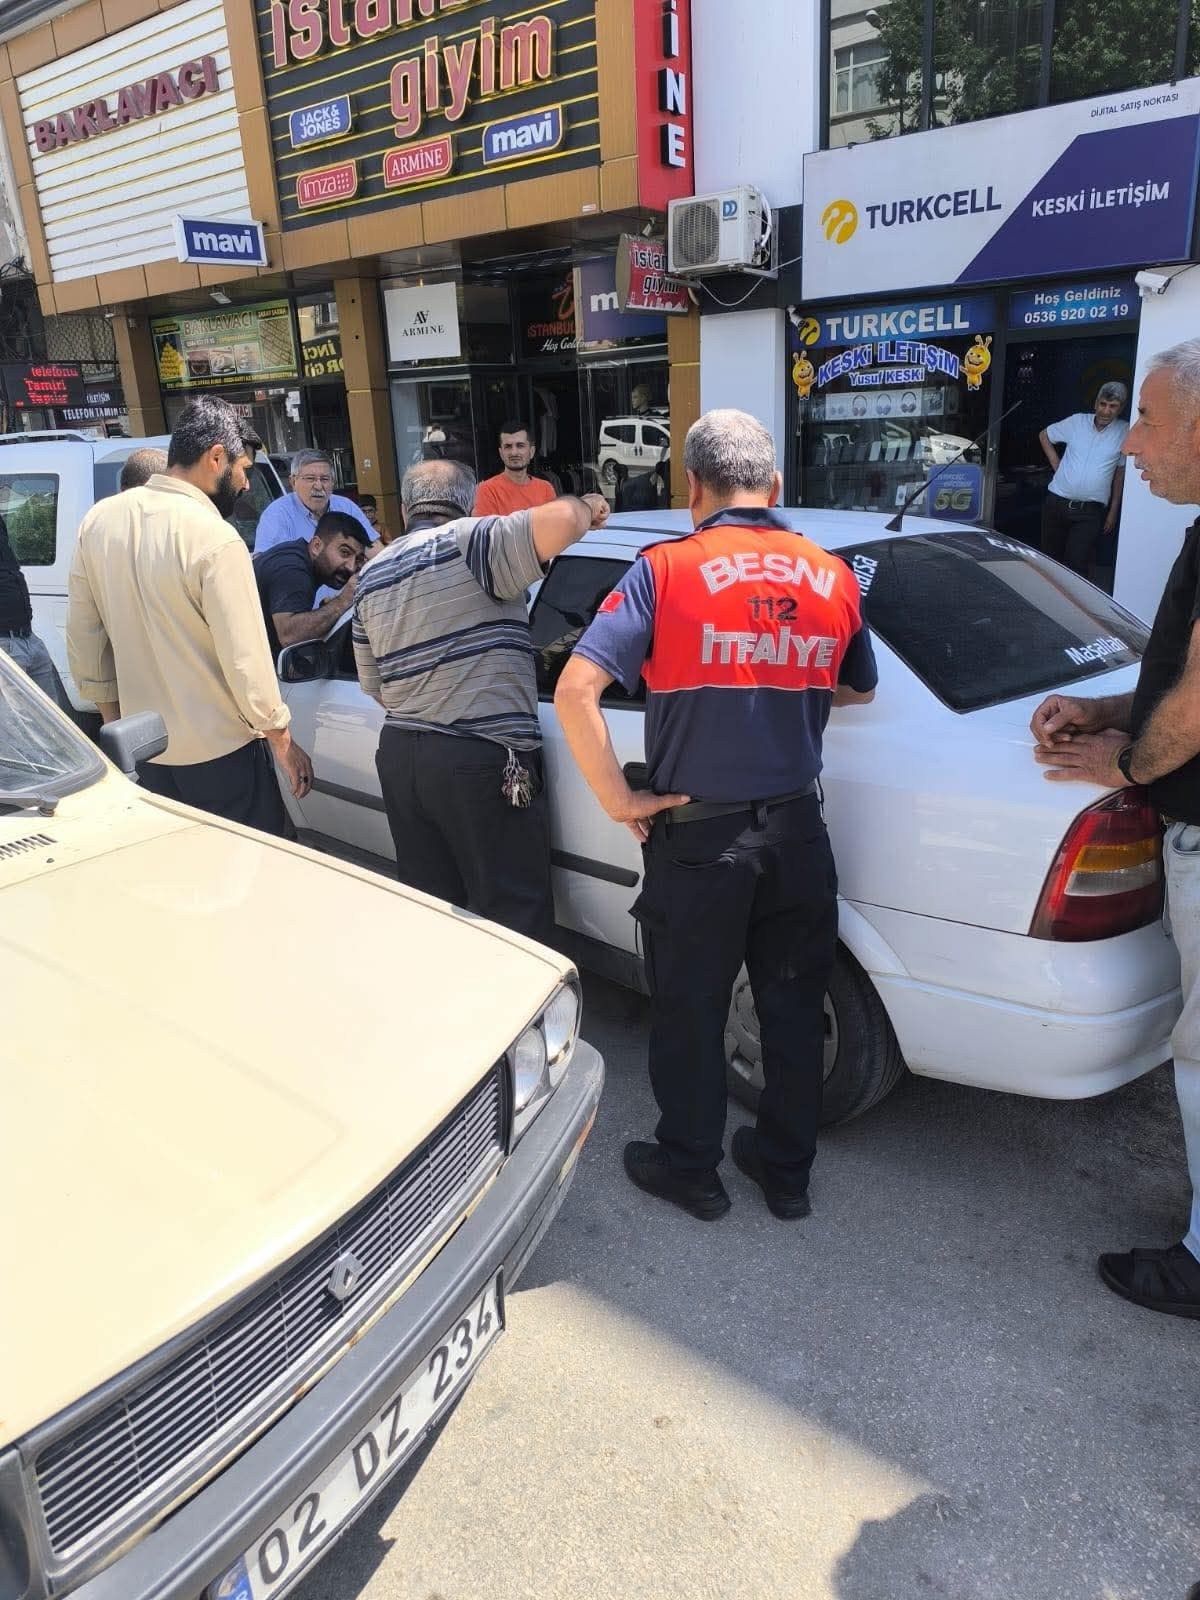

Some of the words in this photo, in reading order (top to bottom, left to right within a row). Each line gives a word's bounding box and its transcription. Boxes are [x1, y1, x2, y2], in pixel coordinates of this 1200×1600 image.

[390, 15, 555, 138] giyim
[33, 55, 220, 153] BAKLAVACI
[299, 103, 340, 127] JACK&
[1120, 101, 1141, 111] SATIŞ
[1143, 93, 1179, 107] NOKTASI
[300, 119, 341, 139] JONES
[492, 113, 553, 152] mavi
[391, 148, 443, 176] ARMİNE
[866, 186, 1001, 229] TURKCELL
[1032, 189, 1085, 217] KESKİ
[1090, 180, 1170, 208] İLETİŞİM
[192, 229, 254, 254] mavi
[1034, 293, 1060, 307] Hoş
[1064, 286, 1121, 302] Geldiniz
[826, 304, 970, 341] TURKCELL
[1024, 310, 1057, 324] 0536
[1061, 307, 1086, 321] 920
[1089, 305, 1107, 318] 02
[1111, 303, 1129, 317] 19
[402, 324, 445, 337] ARMINE
[63, 407, 95, 420] TELEFON
[746, 596, 799, 621] 112
[701, 623, 840, 667] İTFAİYE
[1064, 636, 1129, 666] Maşallah
[258, 1492, 327, 1585] 02
[352, 1392, 409, 1491] DZ
[428, 1293, 493, 1403] 234
